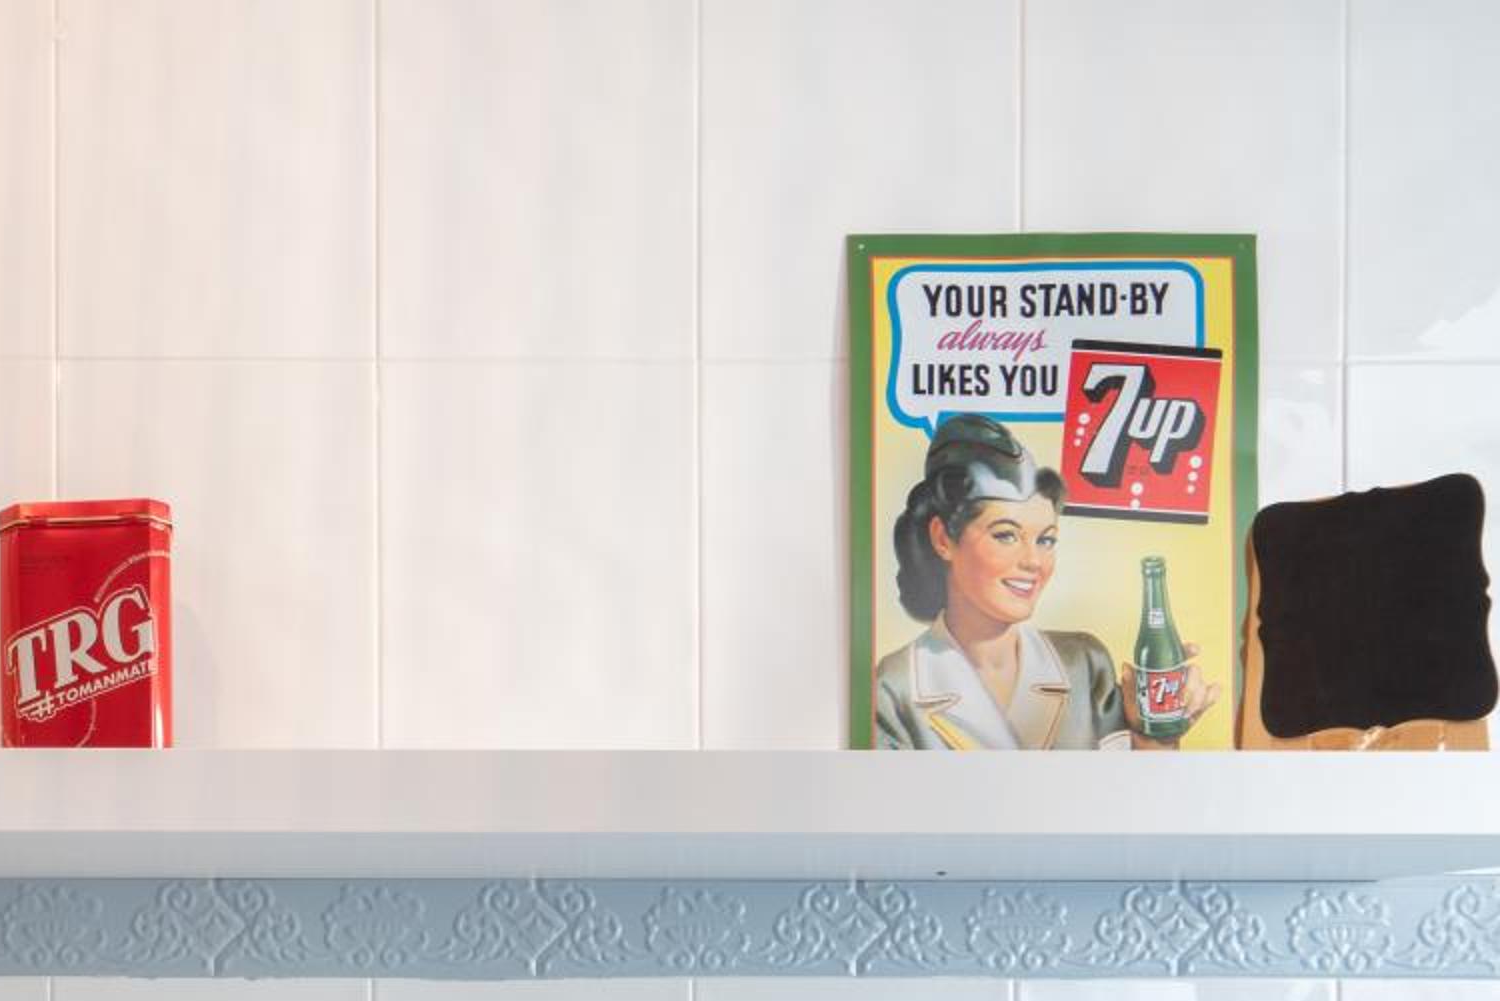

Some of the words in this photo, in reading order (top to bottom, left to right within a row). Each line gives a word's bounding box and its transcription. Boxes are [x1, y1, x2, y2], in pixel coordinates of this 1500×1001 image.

[922, 284, 1008, 317] YOUR
[936, 319, 1047, 361] always
[912, 363, 991, 396] LIKES
[1000, 365, 1059, 396] YOU
[8, 590, 156, 707] TRG
